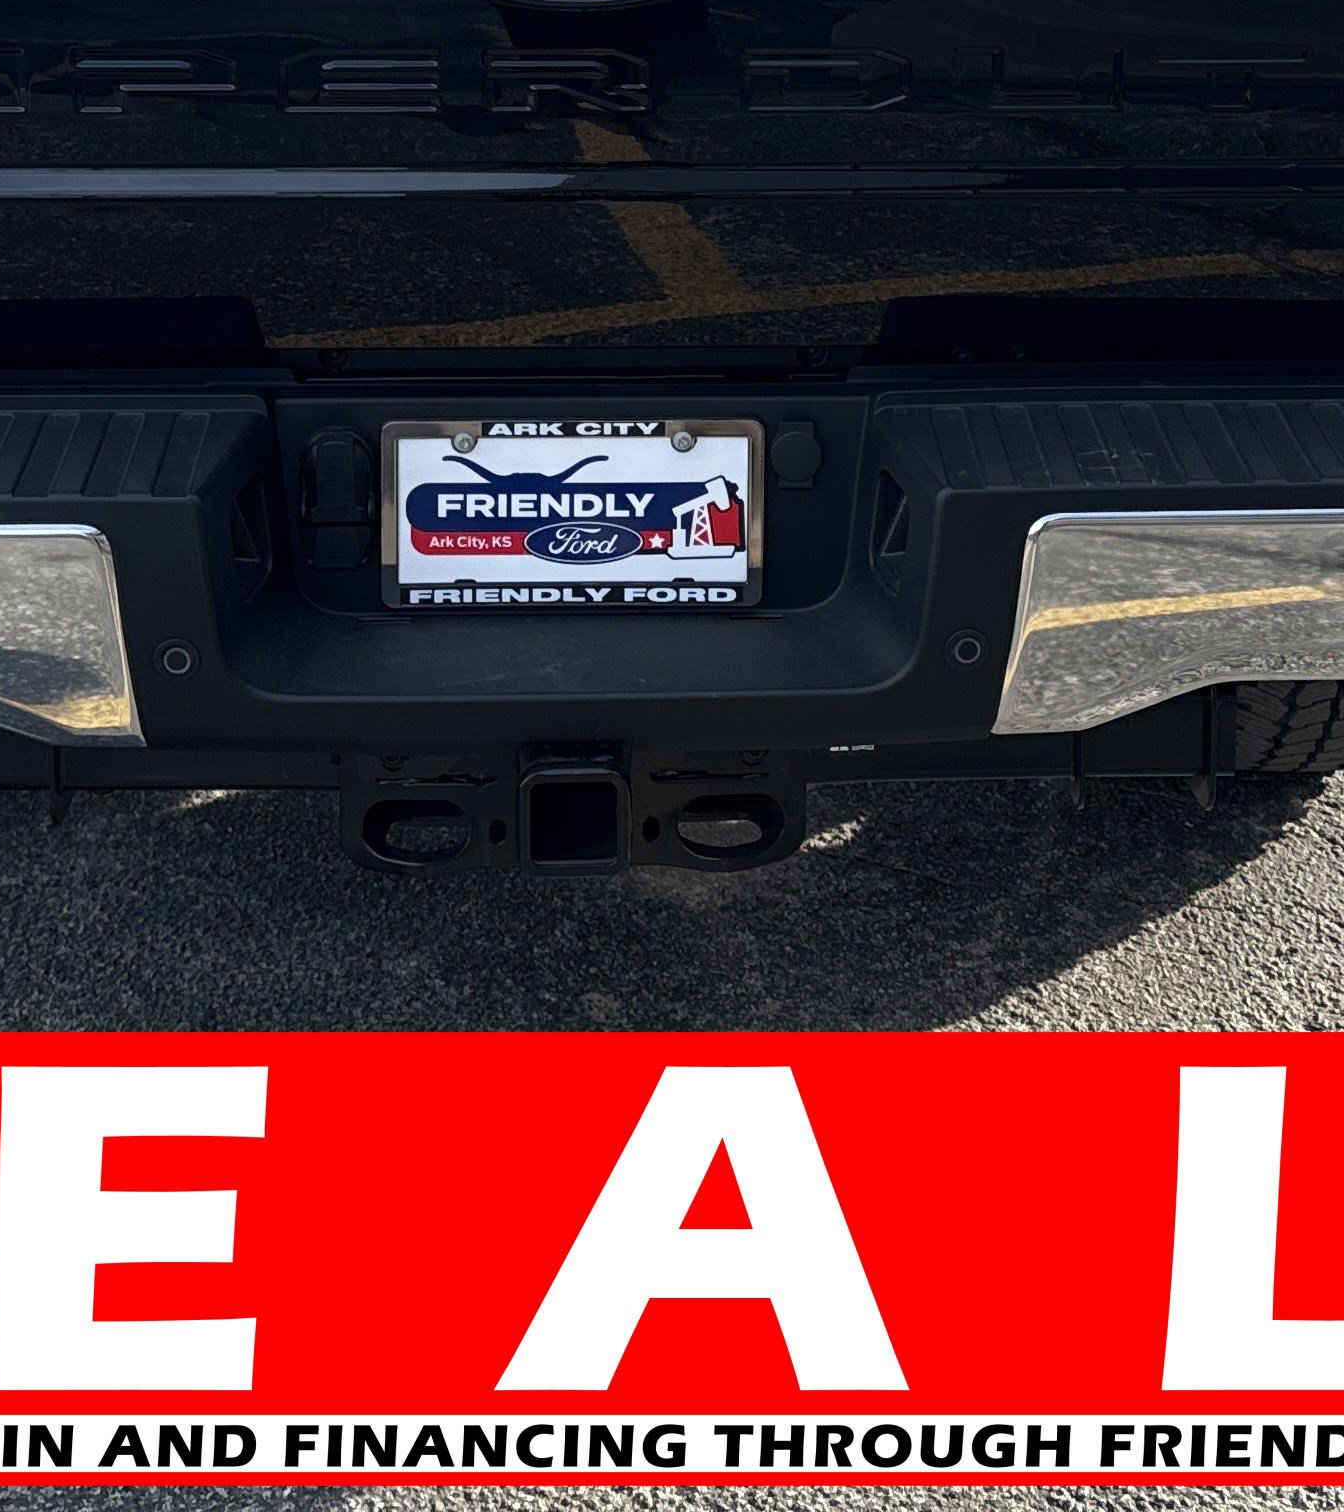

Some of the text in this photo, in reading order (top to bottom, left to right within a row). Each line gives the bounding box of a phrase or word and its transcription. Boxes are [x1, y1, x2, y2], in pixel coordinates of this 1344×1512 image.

[488, 421, 660, 437] ARK CITY
[437, 493, 655, 518] FRIENDLY
[429, 535, 512, 551] Ark City, KS
[547, 526, 618, 556] Ford
[409, 587, 737, 604] FRIENDLY FORD
